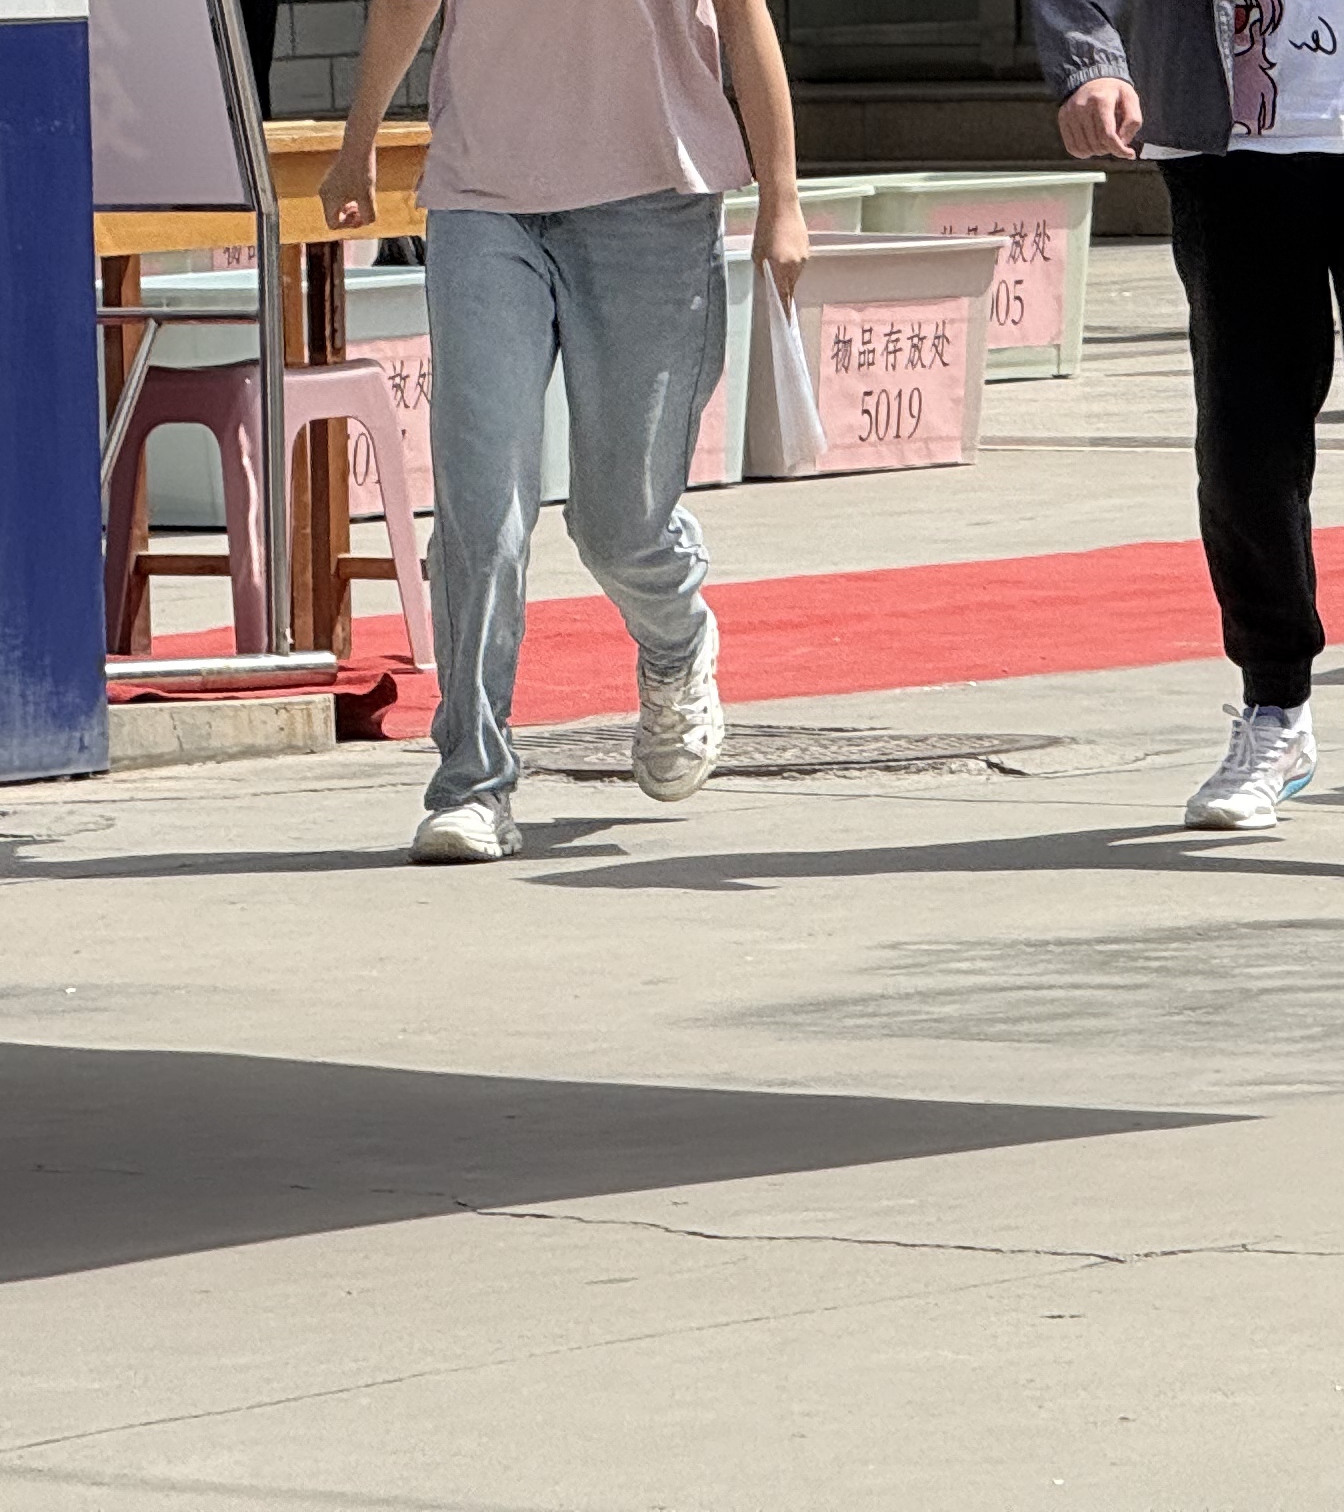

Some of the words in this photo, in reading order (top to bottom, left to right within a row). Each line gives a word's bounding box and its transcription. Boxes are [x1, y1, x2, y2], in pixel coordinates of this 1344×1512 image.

[831, 320, 951, 374] 物品存放处
[858, 386, 923, 443] 5019
